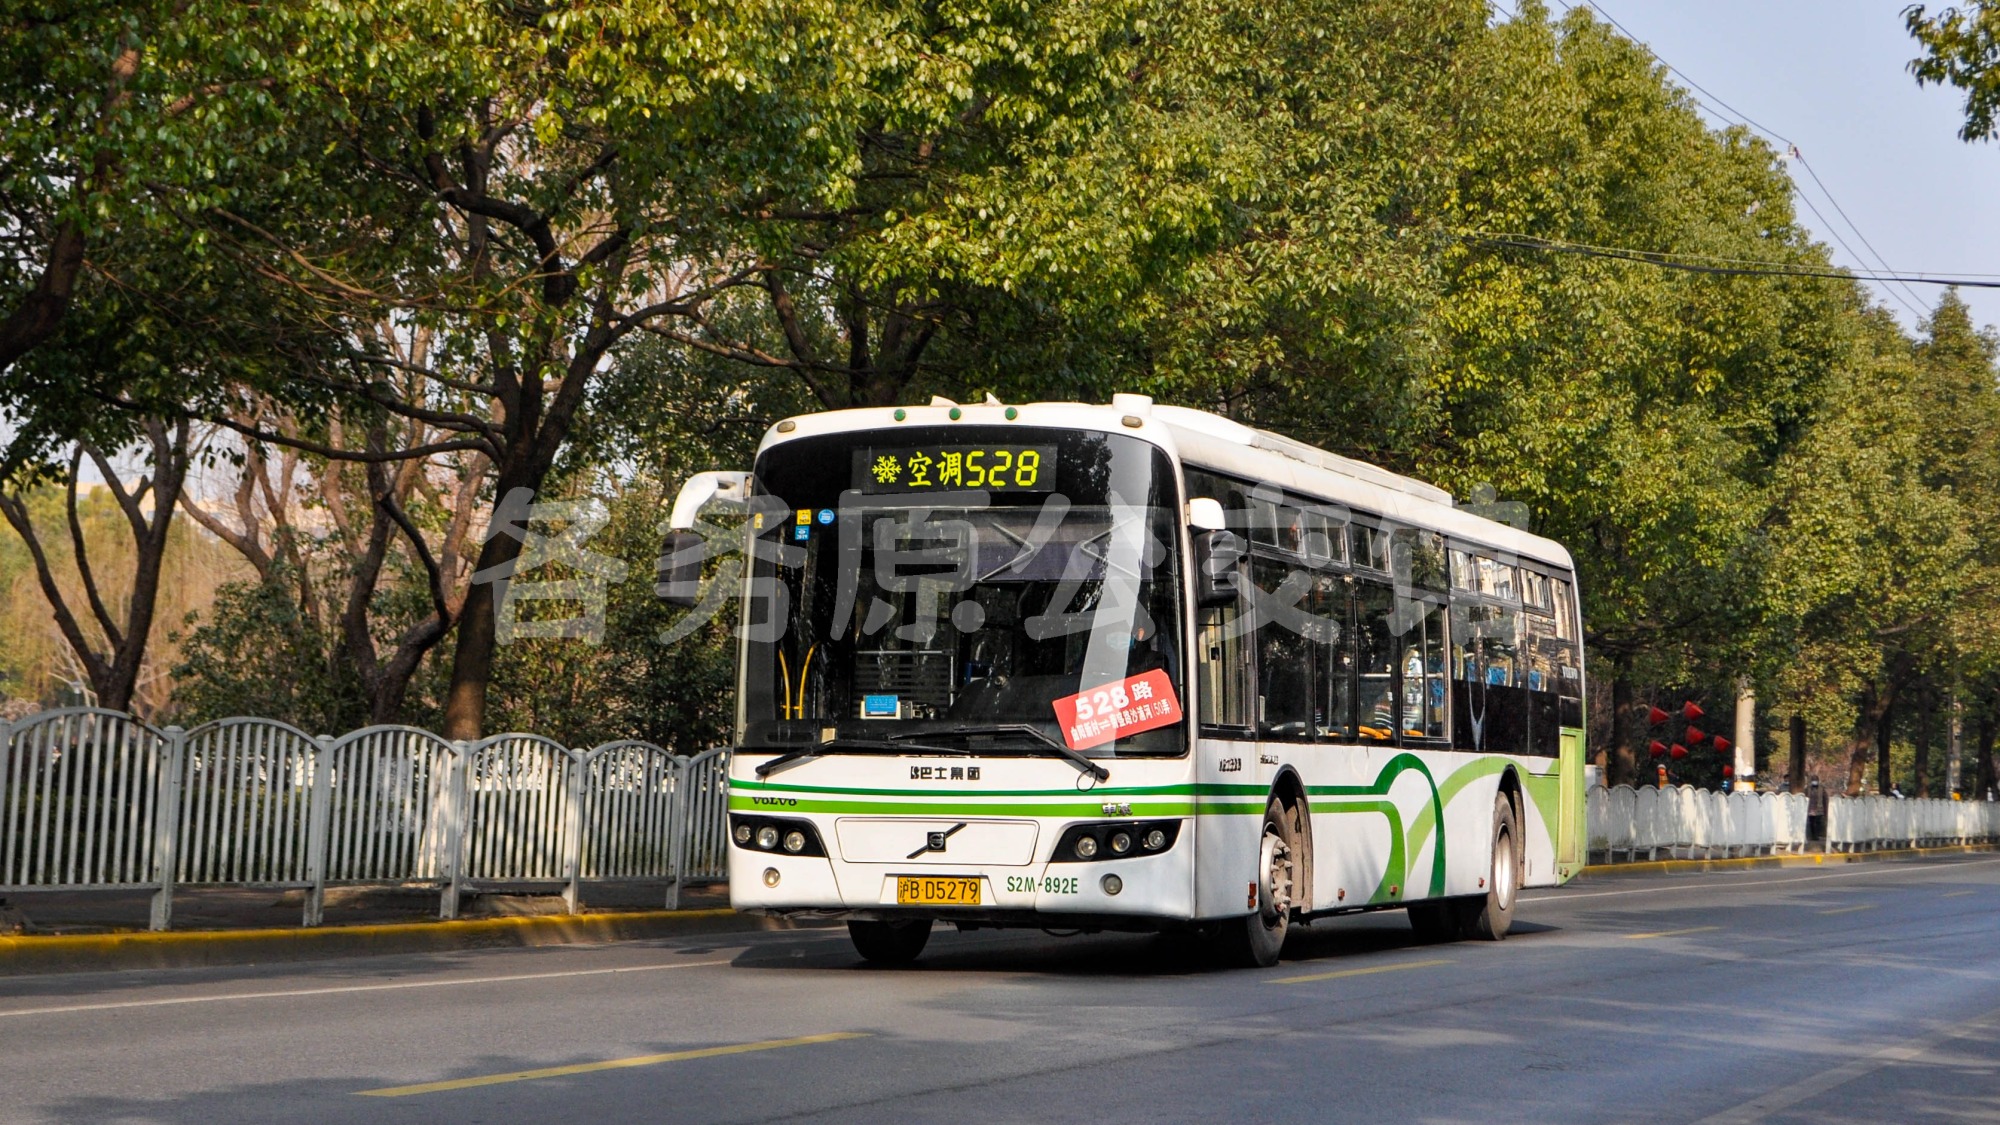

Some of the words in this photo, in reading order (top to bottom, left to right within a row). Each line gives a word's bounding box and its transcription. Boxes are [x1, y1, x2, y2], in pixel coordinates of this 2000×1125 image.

[907, 449, 1041, 488] 空调528
[920, 766, 981, 781] 巴士集团
[752, 796, 798, 807] VOLVO
[1007, 875, 1079, 895] S2M-892E
